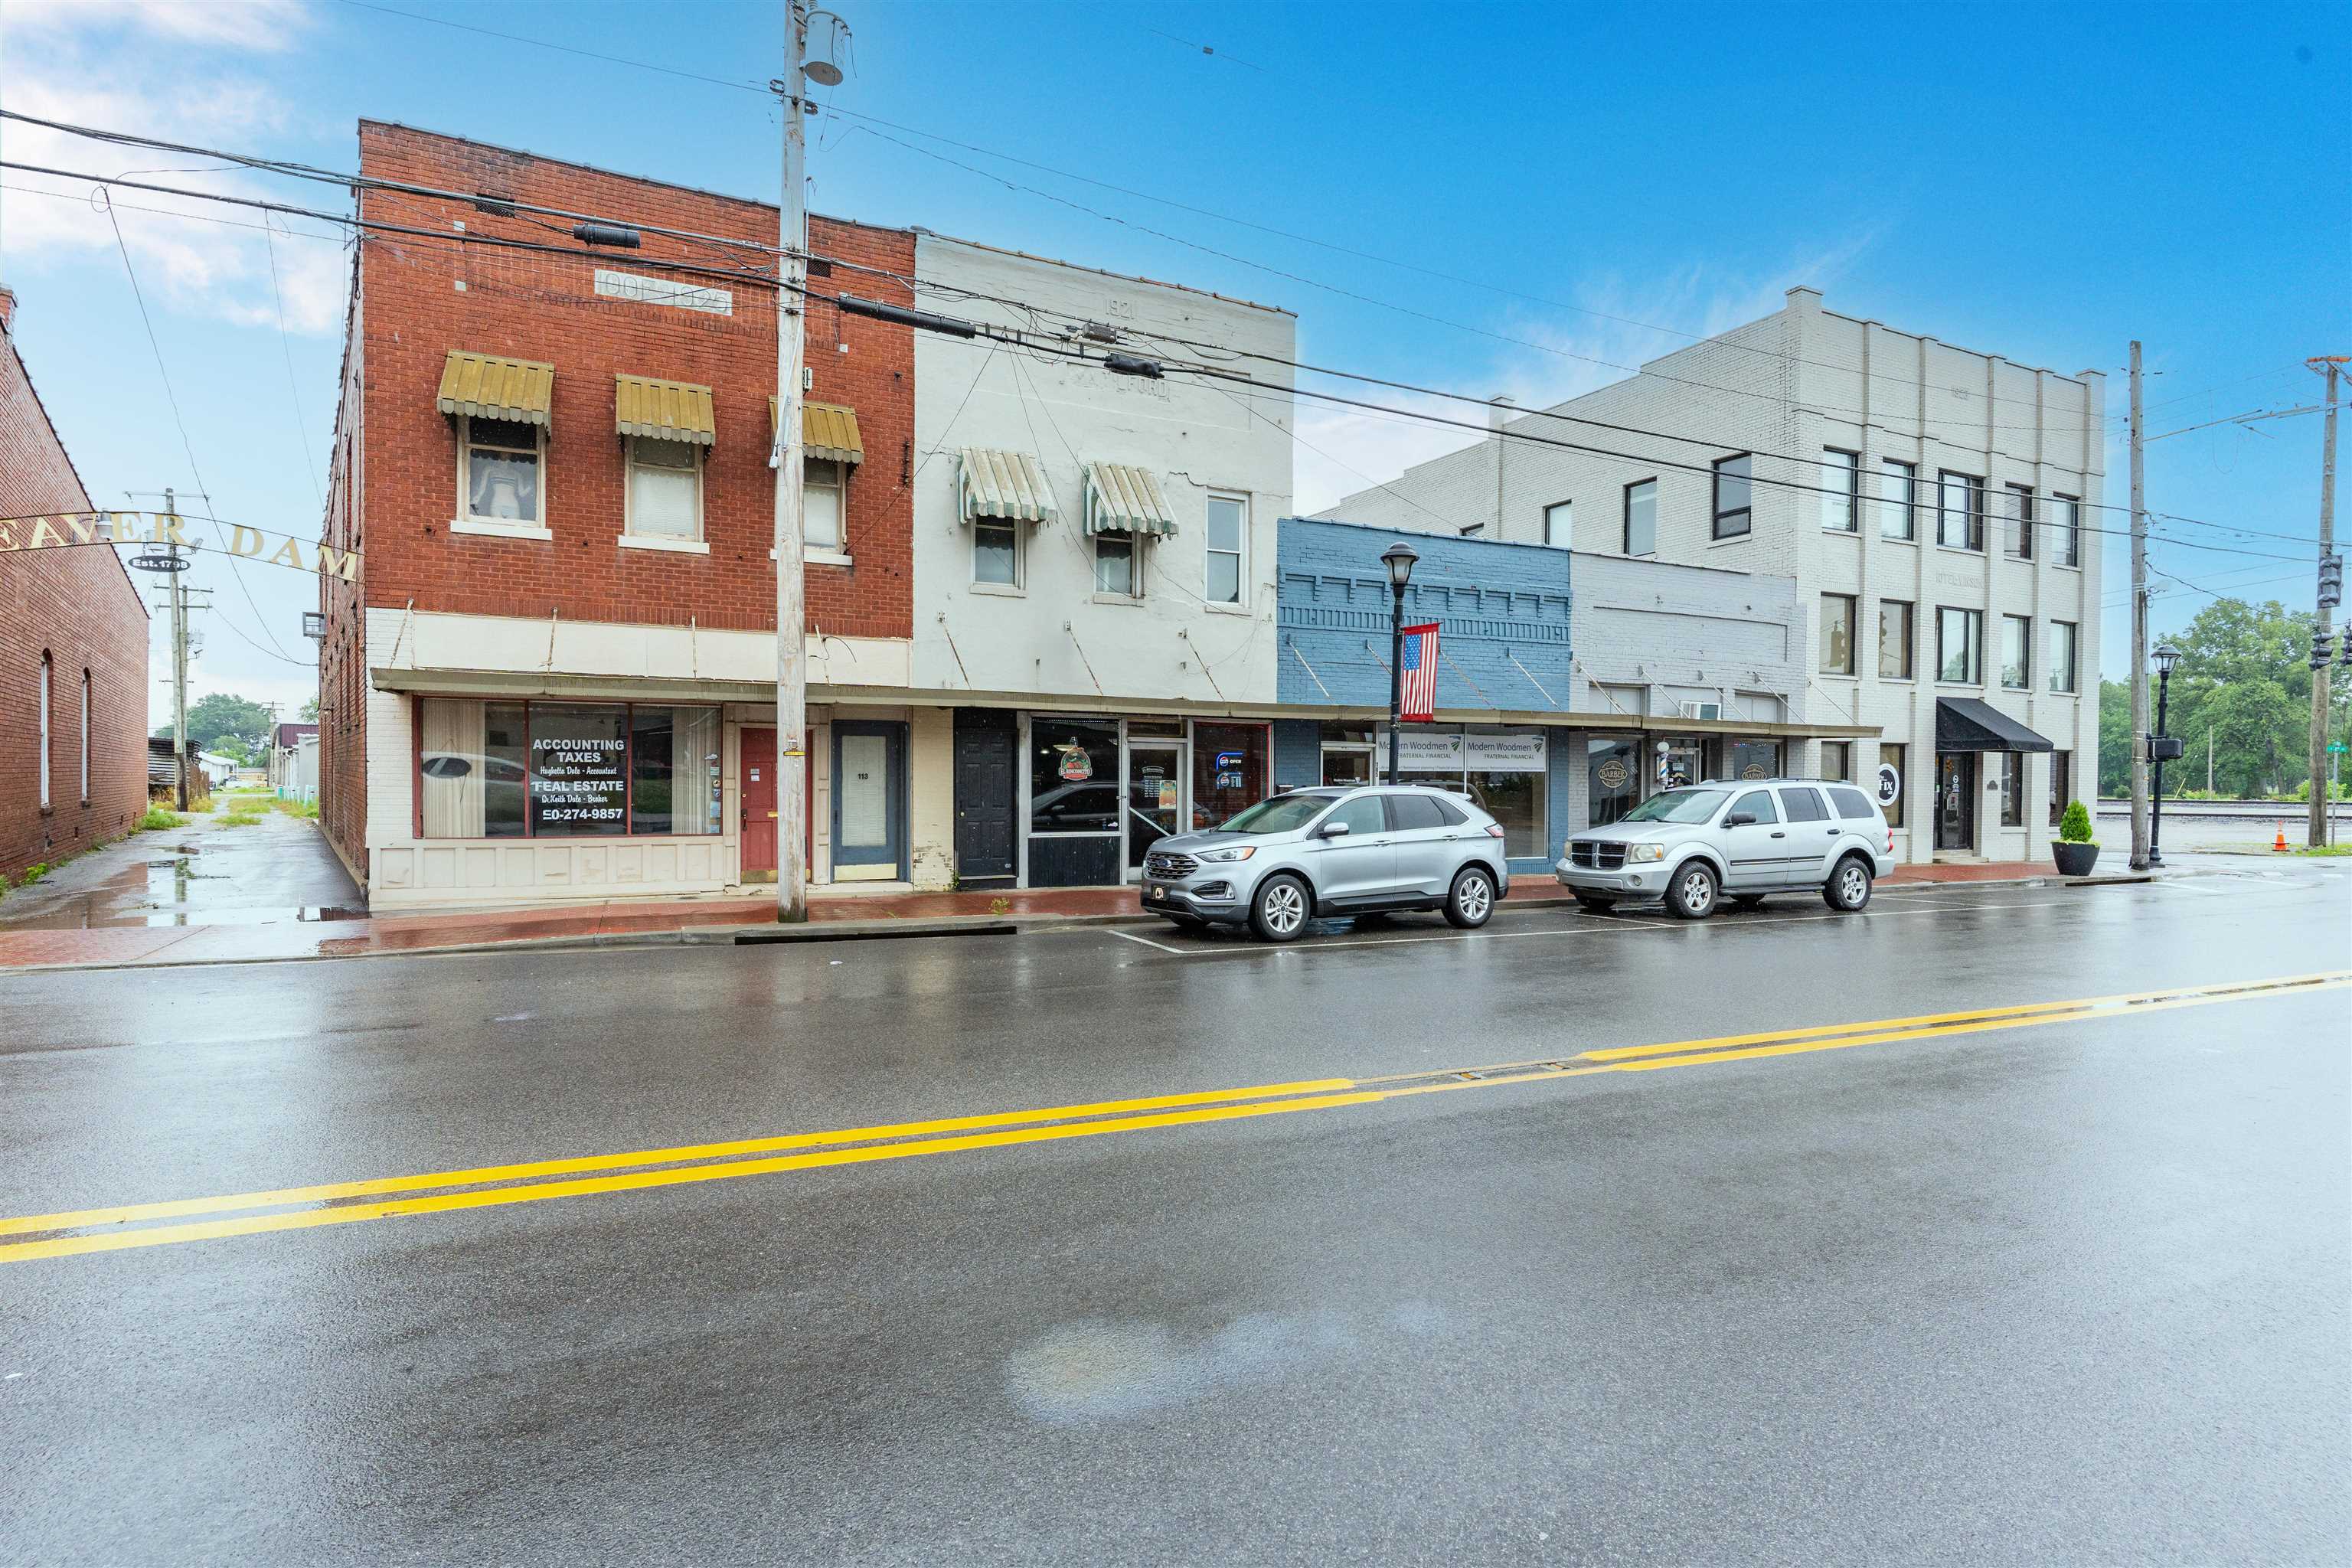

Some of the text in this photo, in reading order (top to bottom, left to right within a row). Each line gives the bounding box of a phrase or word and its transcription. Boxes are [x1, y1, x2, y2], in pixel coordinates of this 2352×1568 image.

[229, 524, 357, 582] DAM
[532, 739, 625, 750] ACCOUNTING
[1379, 741, 1448, 750] Moern Woodmen
[1468, 743, 1531, 752] Modern Woodmen
[557, 752, 601, 763] TAXES
[567, 766, 581, 775] Dale
[586, 766, 617, 775] Accountant
[574, 780, 624, 792] ESTATE
[567, 794, 582, 803] Dale
[587, 794, 609, 804] Broker
